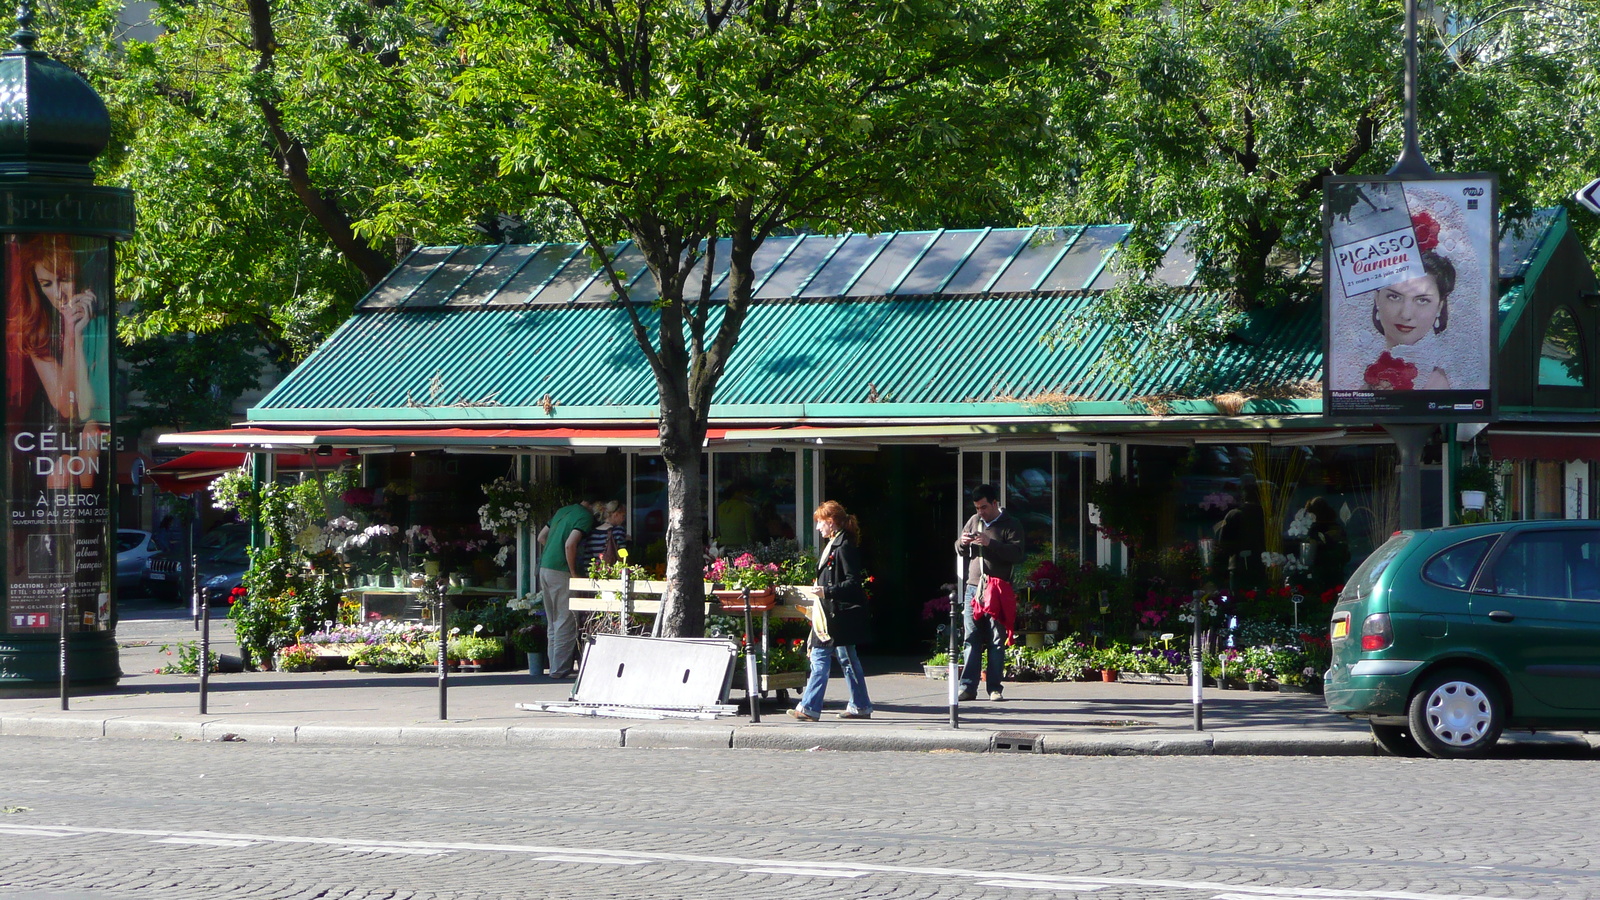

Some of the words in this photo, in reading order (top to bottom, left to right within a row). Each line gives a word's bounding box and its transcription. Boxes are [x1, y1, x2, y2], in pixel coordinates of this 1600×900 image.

[1339, 235, 1414, 267] PICASSO
[1353, 253, 1410, 275] Carmen
[1395, 265, 1410, 274] 2007
[14, 425, 108, 451] CÉLINE
[36, 456, 100, 475] DION
[36, 490, 49, 507] À
[56, 493, 100, 507] BERCY
[12, 510, 25, 518] DU
[32, 509, 45, 517] 19
[63, 508, 76, 517] 27
[78, 507, 93, 517] MAI
[76, 534, 100, 545] nouvel
[76, 546, 98, 557] album
[76, 559, 102, 573] français
[14, 615, 46, 626] TF1
